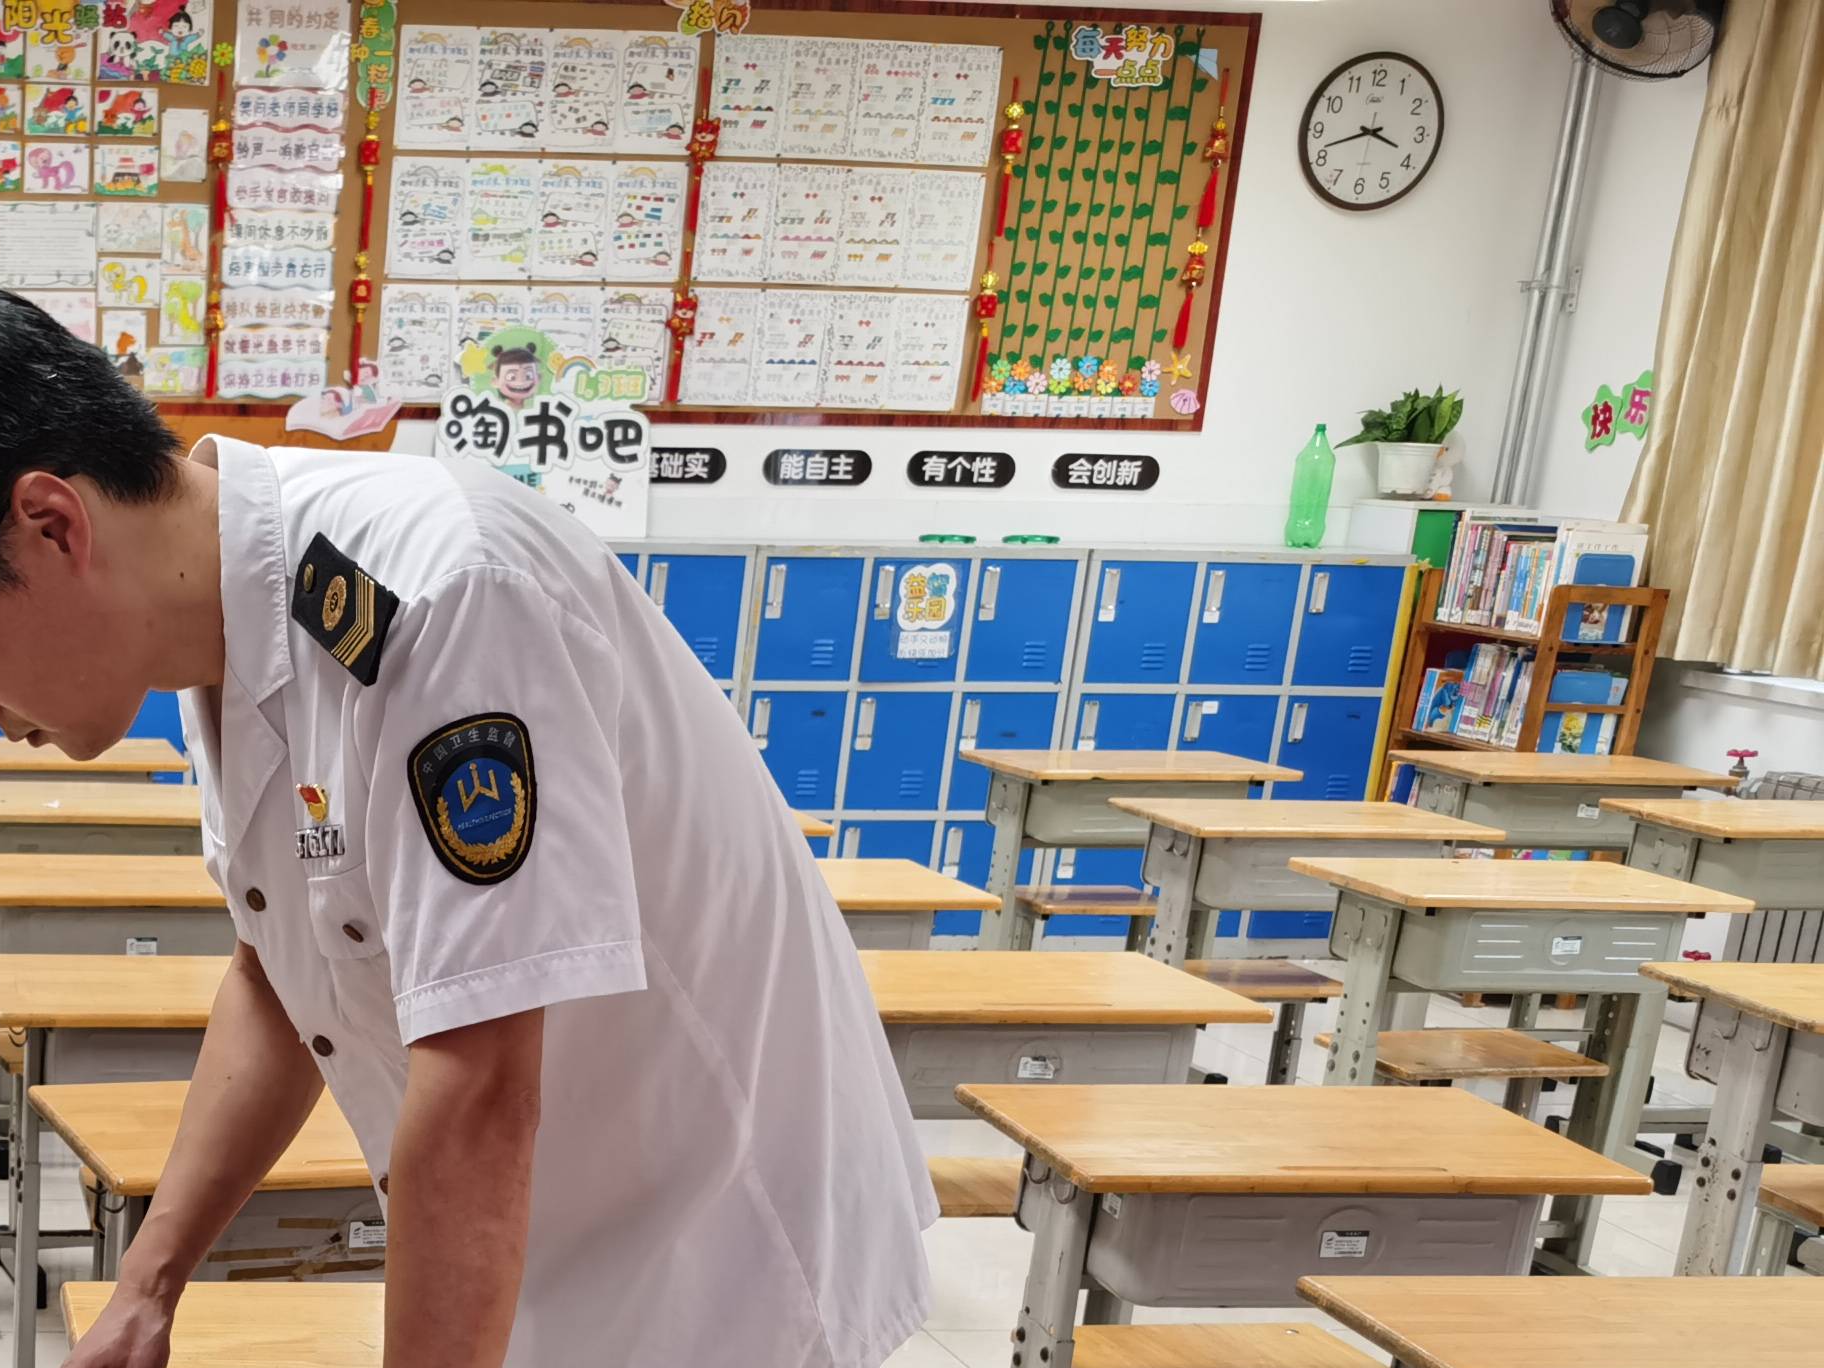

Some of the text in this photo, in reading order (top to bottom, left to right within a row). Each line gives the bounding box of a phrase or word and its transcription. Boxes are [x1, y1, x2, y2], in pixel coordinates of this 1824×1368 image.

[247, 8, 339, 30] 共同的约定
[1075, 27, 1173, 60] 每天努力
[1094, 60, 1161, 83] 一点点
[1371, 69, 1388, 87] 12
[1348, 75, 1361, 93] 11
[1399, 78, 1406, 96] 1
[1326, 95, 1343, 114] 10
[1410, 98, 1423, 115] 2
[1312, 121, 1325, 139] 9
[1413, 126, 1426, 144] 3
[1315, 149, 1327, 167] 8
[1399, 153, 1411, 170] 4
[1333, 168, 1344, 186] 7
[1353, 177, 1366, 195] 6
[1378, 171, 1391, 190] 5
[1591, 387, 1654, 440] 快乐
[445, 395, 643, 465] 淘书吧
[779, 454, 854, 480] 能自主
[922, 456, 997, 483] 有个性
[1068, 459, 1142, 486] 会创新
[422, 726, 517, 775] 中国卫生监督
